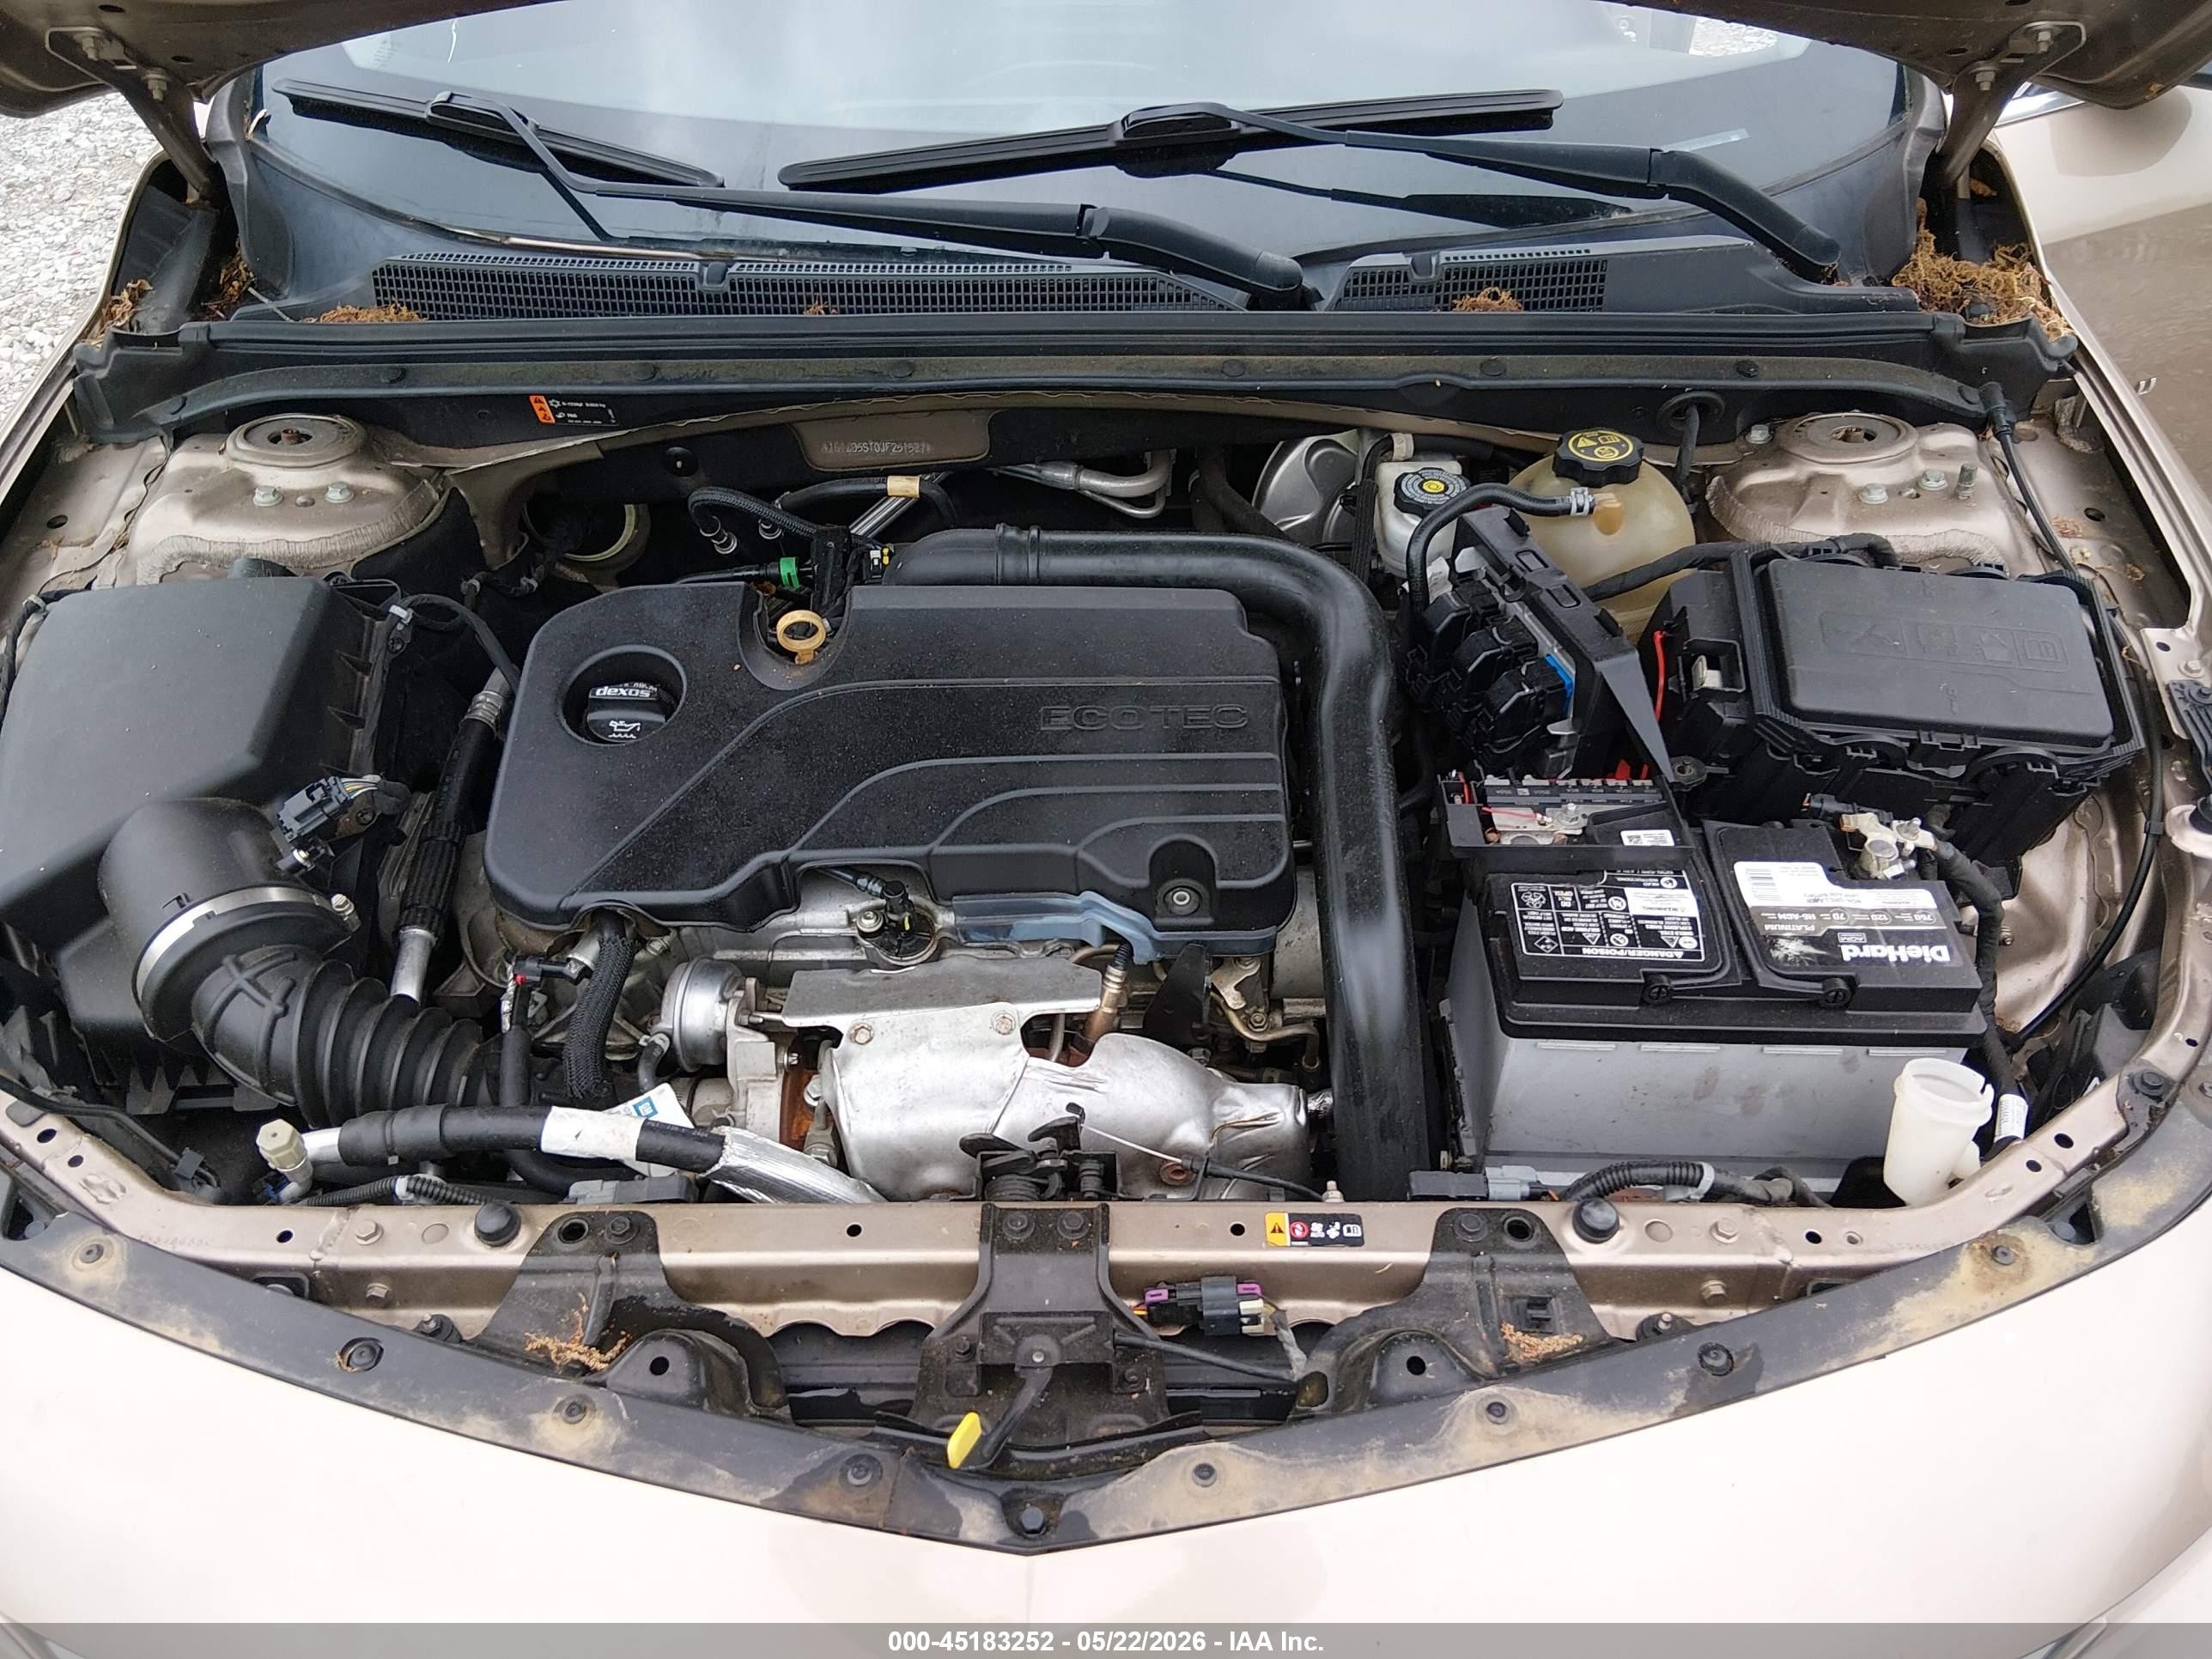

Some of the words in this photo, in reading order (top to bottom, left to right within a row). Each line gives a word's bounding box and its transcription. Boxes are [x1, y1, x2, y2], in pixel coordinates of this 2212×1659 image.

[595, 685, 652, 698] dexos
[1039, 704, 1248, 731] ECOTEC
[1870, 913, 1889, 921] 120
[1582, 947, 1674, 957] DANGER/POISON
[1840, 945, 1951, 963] DieHard
